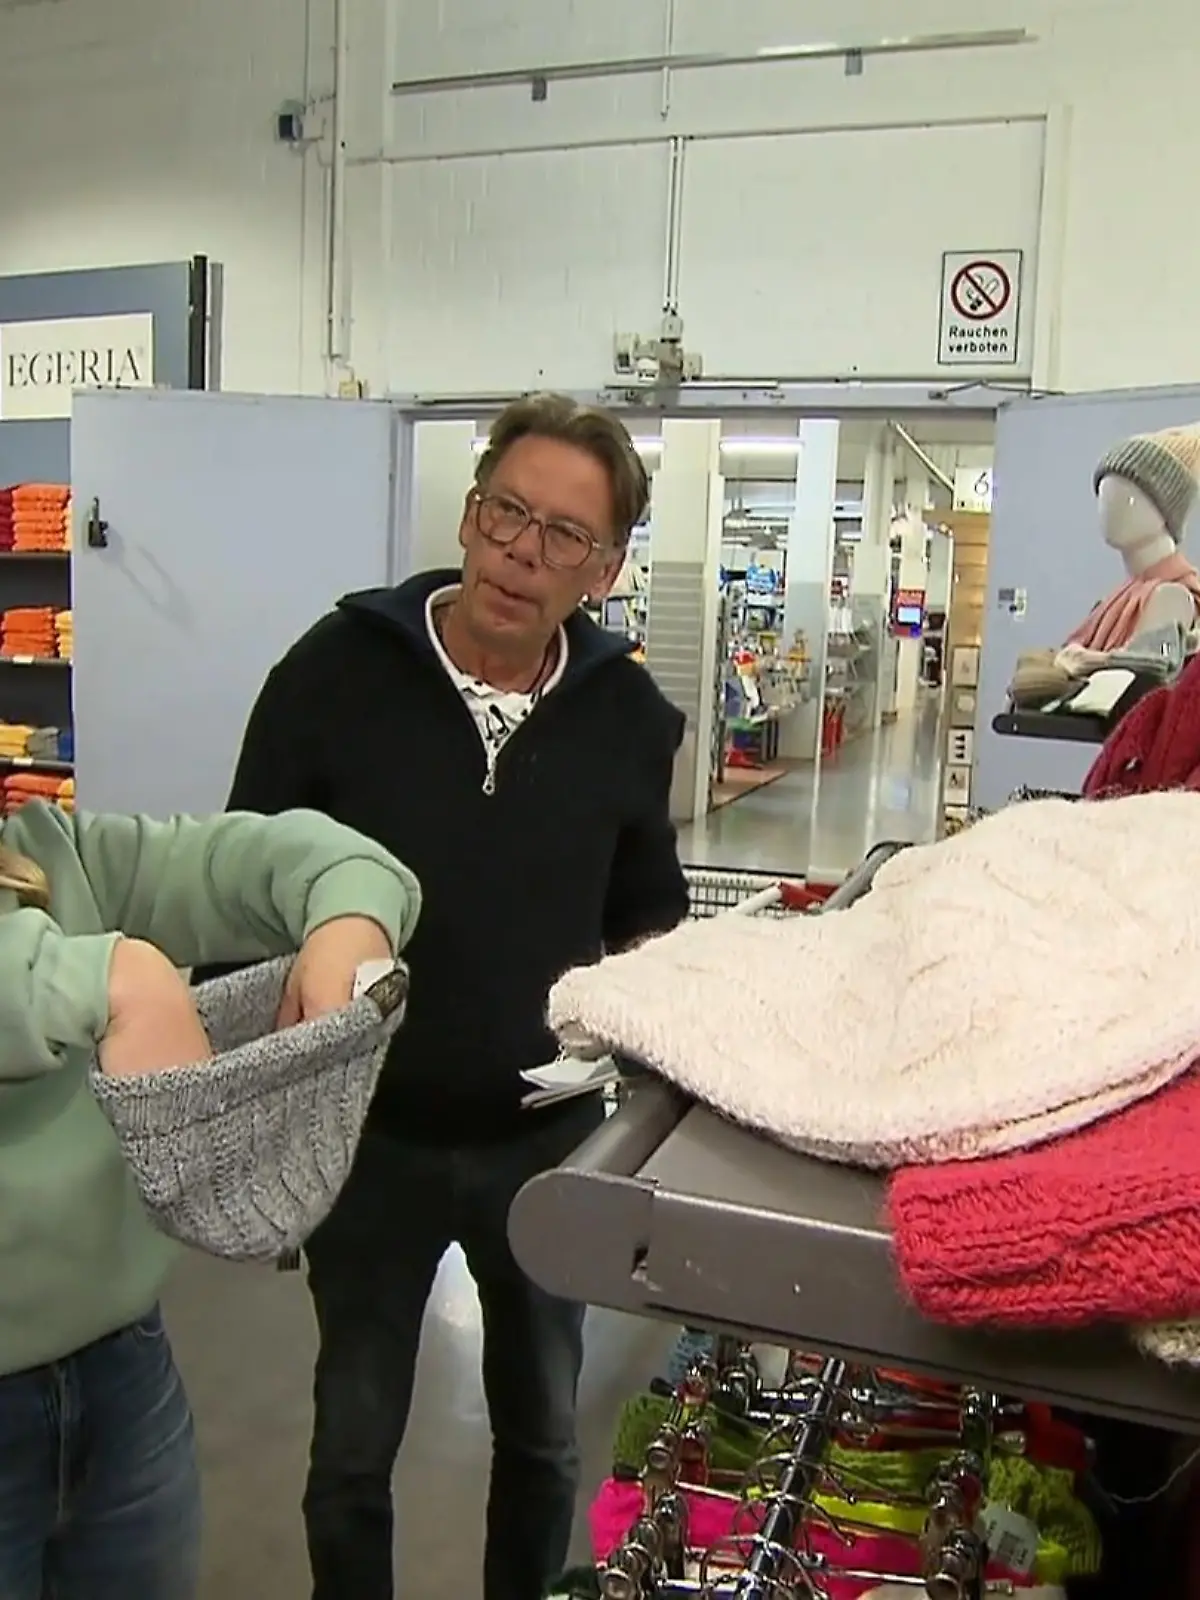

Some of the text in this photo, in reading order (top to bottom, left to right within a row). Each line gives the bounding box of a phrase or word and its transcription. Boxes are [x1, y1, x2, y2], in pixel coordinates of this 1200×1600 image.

[949, 325, 1008, 338] Rauchen
[949, 341, 1008, 353] verboten
[8, 348, 141, 388] EGERIA
[974, 471, 989, 497] 6
